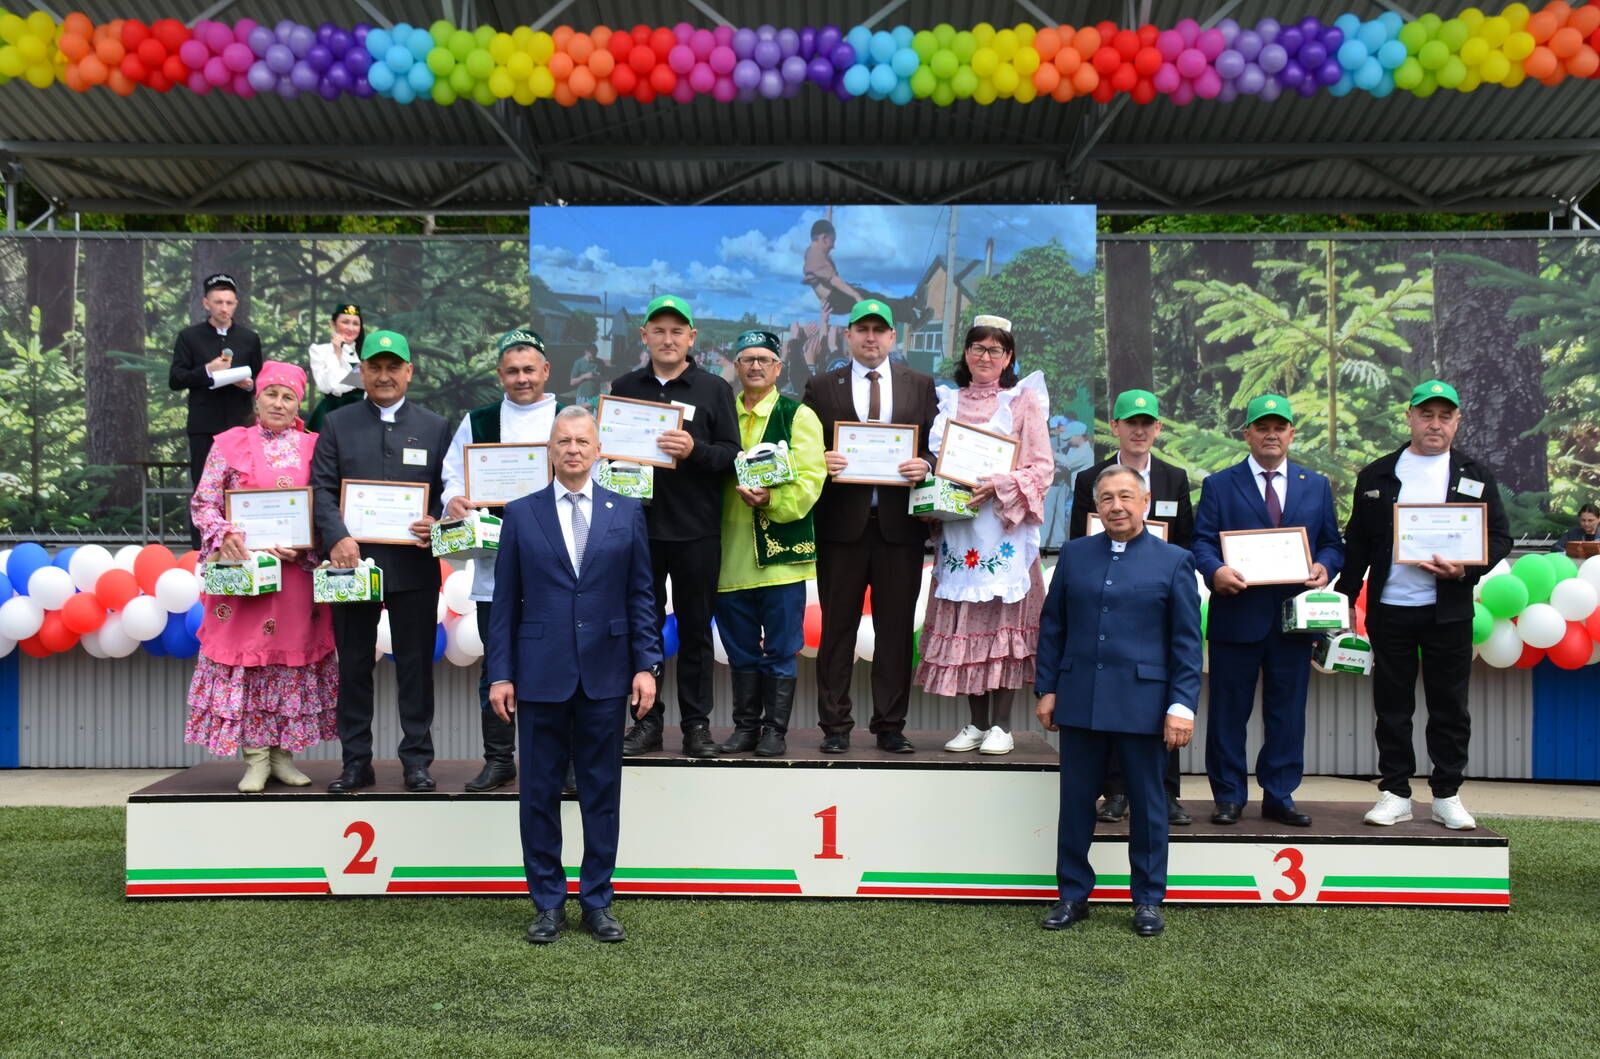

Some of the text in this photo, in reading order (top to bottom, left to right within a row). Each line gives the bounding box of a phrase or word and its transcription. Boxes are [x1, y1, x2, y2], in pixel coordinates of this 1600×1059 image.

[342, 820, 378, 875] 2
[814, 805, 844, 859] 1
[1272, 847, 1307, 902] 3
